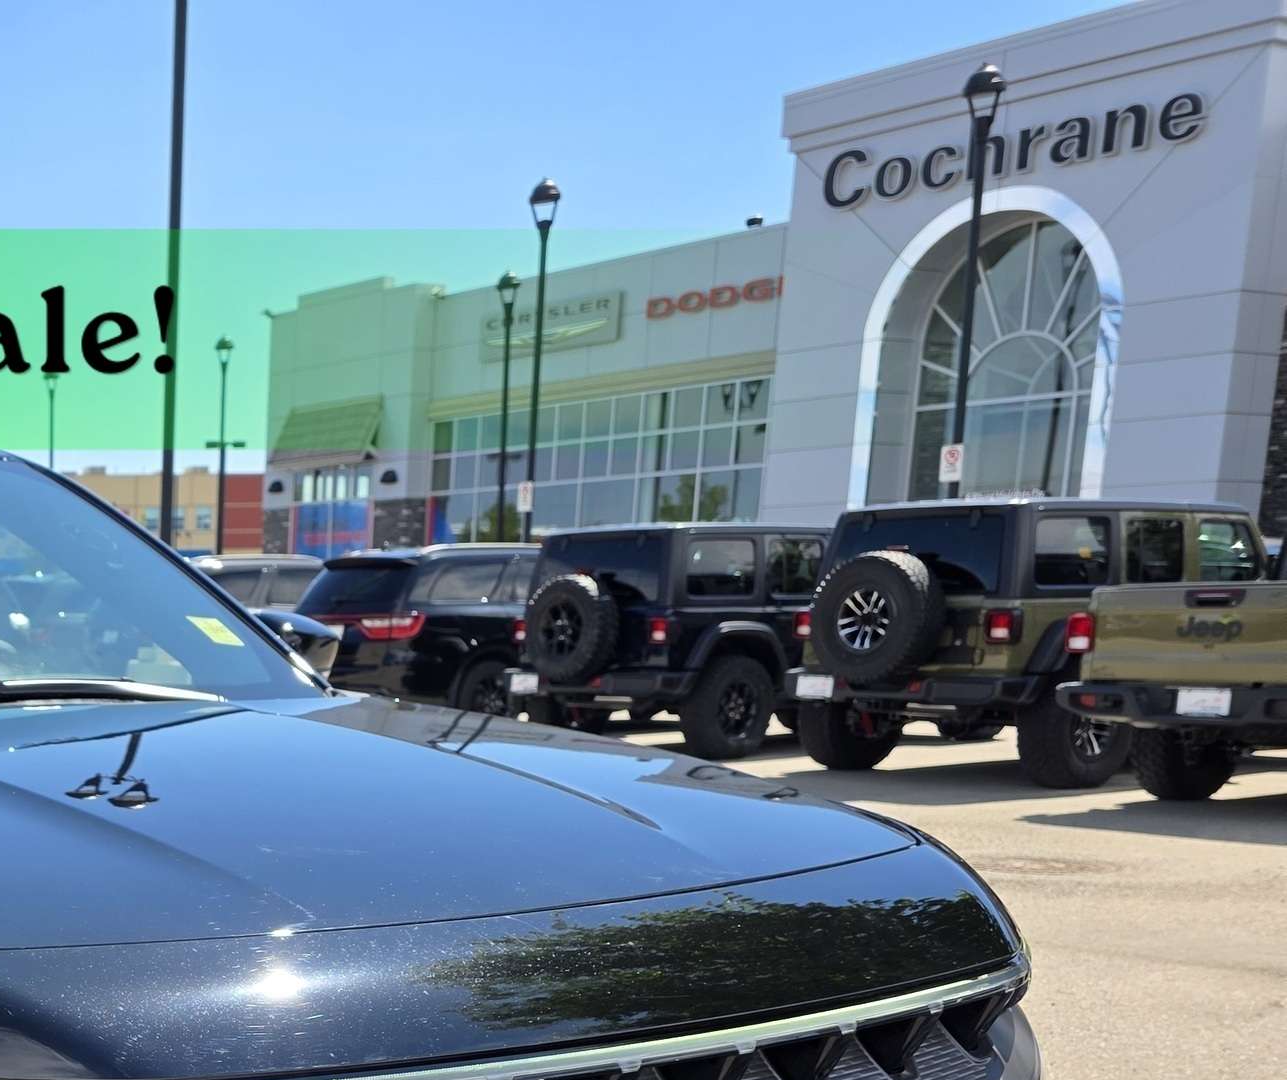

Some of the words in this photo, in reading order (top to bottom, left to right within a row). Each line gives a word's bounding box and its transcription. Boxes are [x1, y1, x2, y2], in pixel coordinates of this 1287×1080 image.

[823, 92, 1205, 208] Cochrane
[485, 298, 610, 331] CRSLER
[645, 274, 784, 319] DODG
